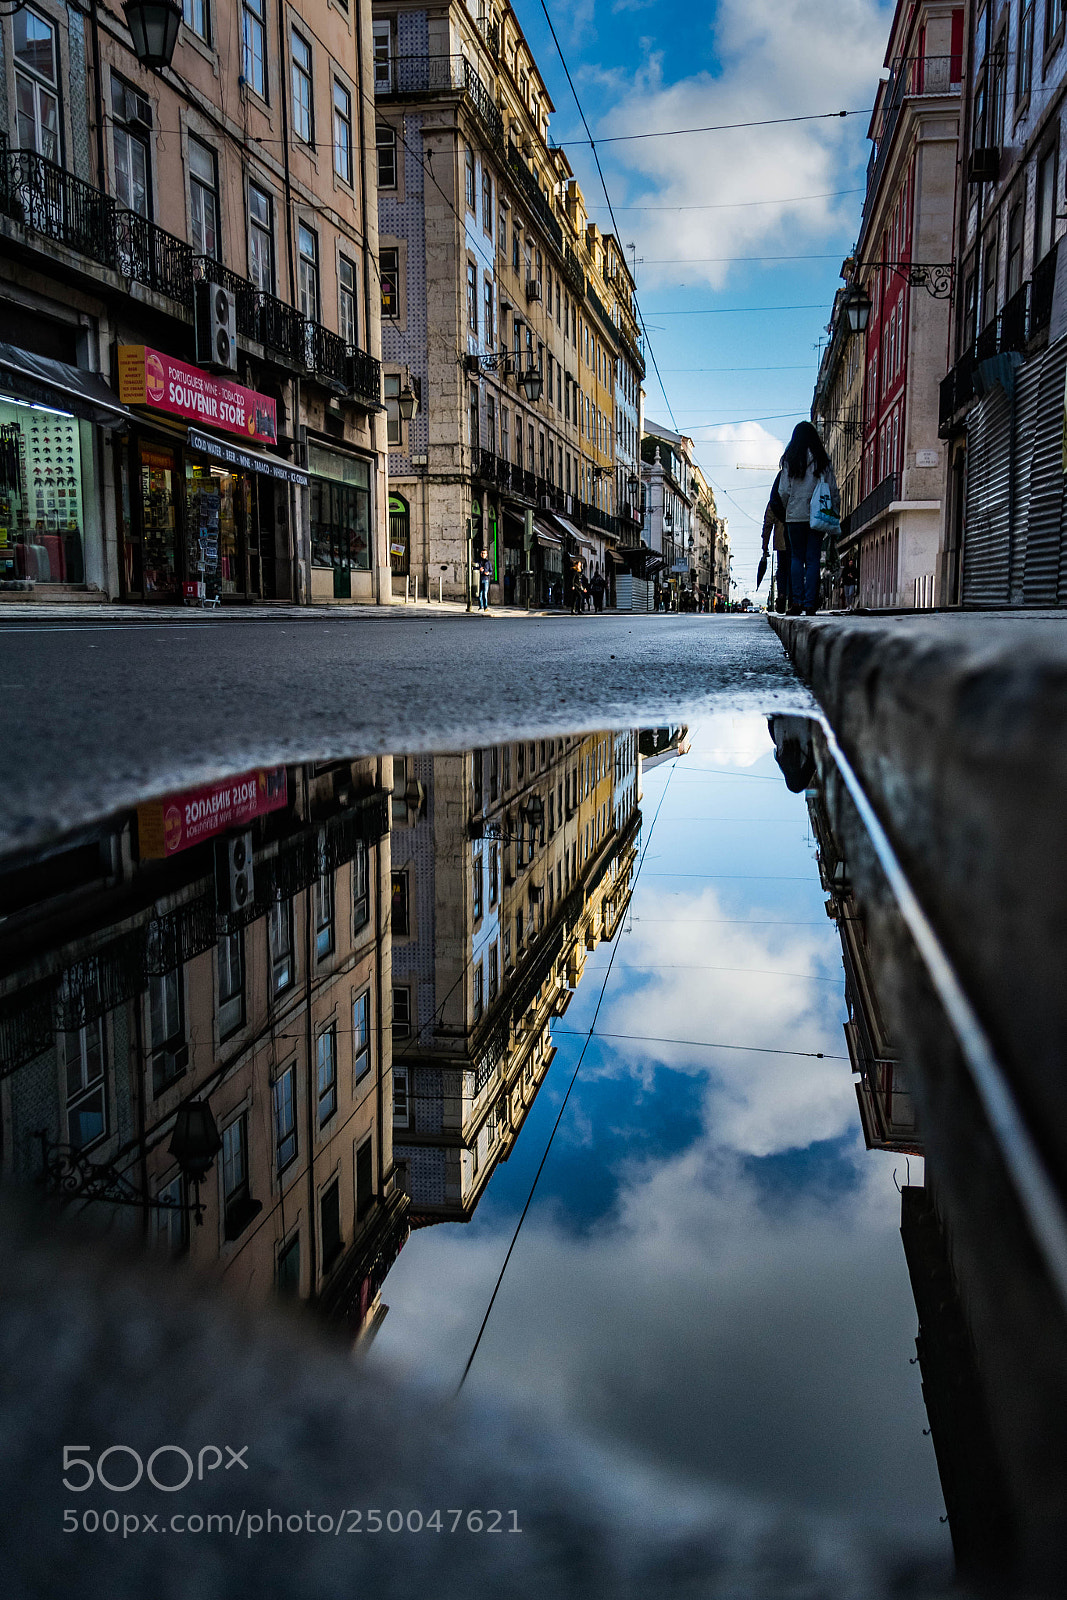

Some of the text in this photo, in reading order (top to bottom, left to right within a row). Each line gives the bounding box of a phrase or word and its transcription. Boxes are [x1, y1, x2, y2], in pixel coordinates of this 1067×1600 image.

[168, 366, 203, 391] PORTUGUESE
[204, 381, 218, 396] WINE
[222, 388, 244, 406] TOBACCO
[169, 382, 245, 427] SOUVENIR STORE
[194, 436, 206, 451] COLD
[206, 441, 222, 457] WATER
[226, 450, 236, 461] BEER
[240, 455, 250, 468] WINE
